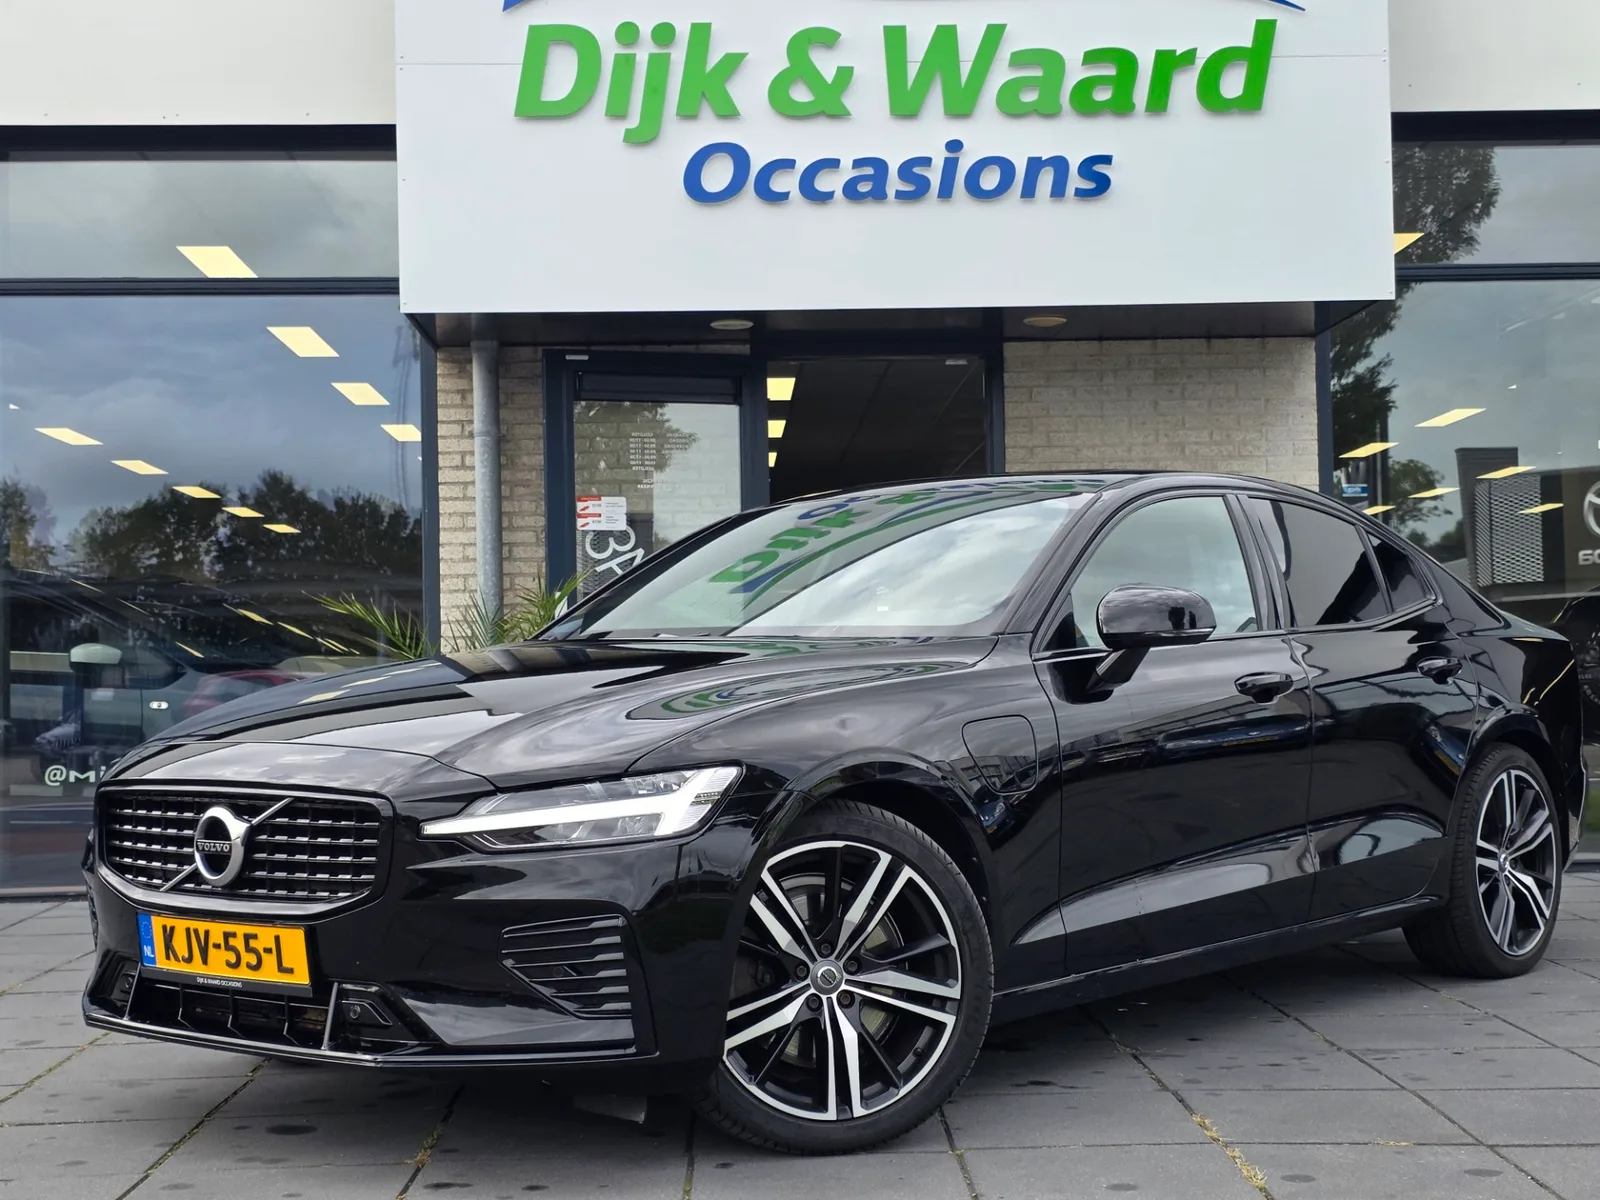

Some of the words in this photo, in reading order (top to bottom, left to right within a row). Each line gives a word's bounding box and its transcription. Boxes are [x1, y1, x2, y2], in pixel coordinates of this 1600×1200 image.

[515, 22, 746, 144] Dijk
[769, 27, 854, 117] &
[883, 19, 1277, 117] Waard
[684, 140, 1113, 204] Occasions
[197, 842, 230, 852] VOLVO
[143, 945, 154, 957] NL
[162, 923, 294, 975] KJV-55-L
